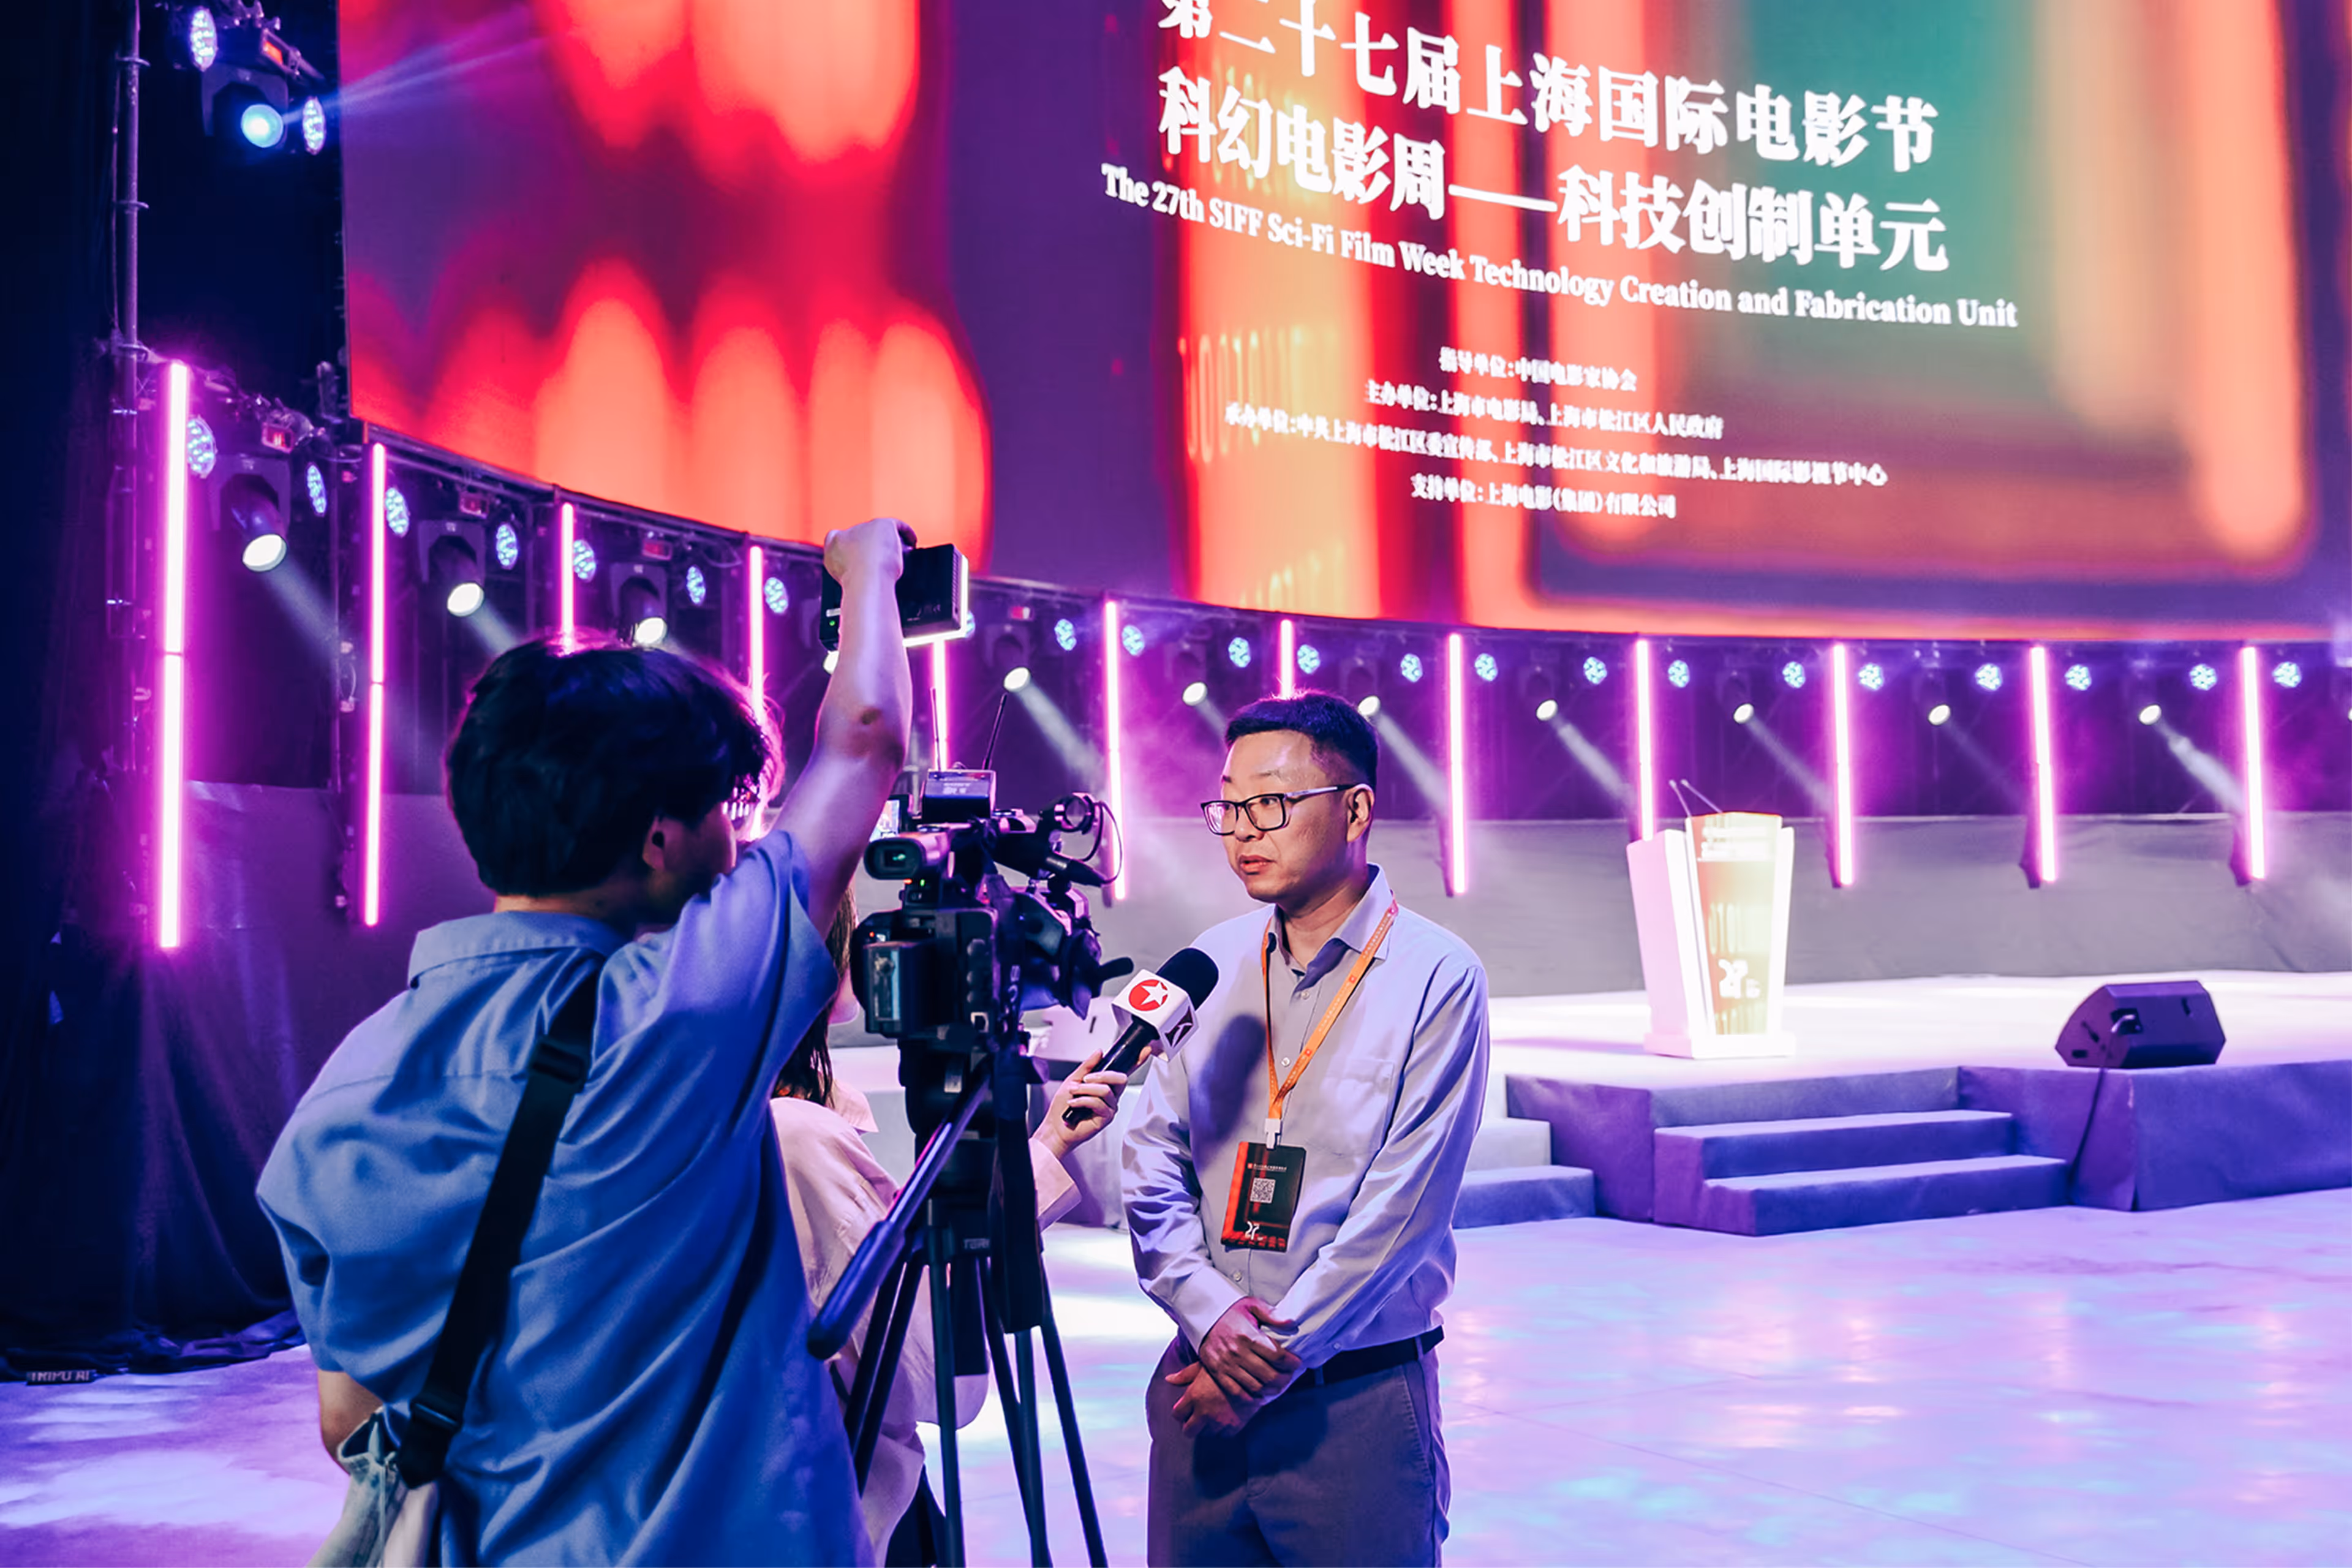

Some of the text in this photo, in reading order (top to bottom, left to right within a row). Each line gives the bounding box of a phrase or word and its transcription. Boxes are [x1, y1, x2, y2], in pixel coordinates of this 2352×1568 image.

[1102, 164, 2018, 328] The 27th SIFF Sci-Fi Film Week Technology Creation and Fabrication Unit
